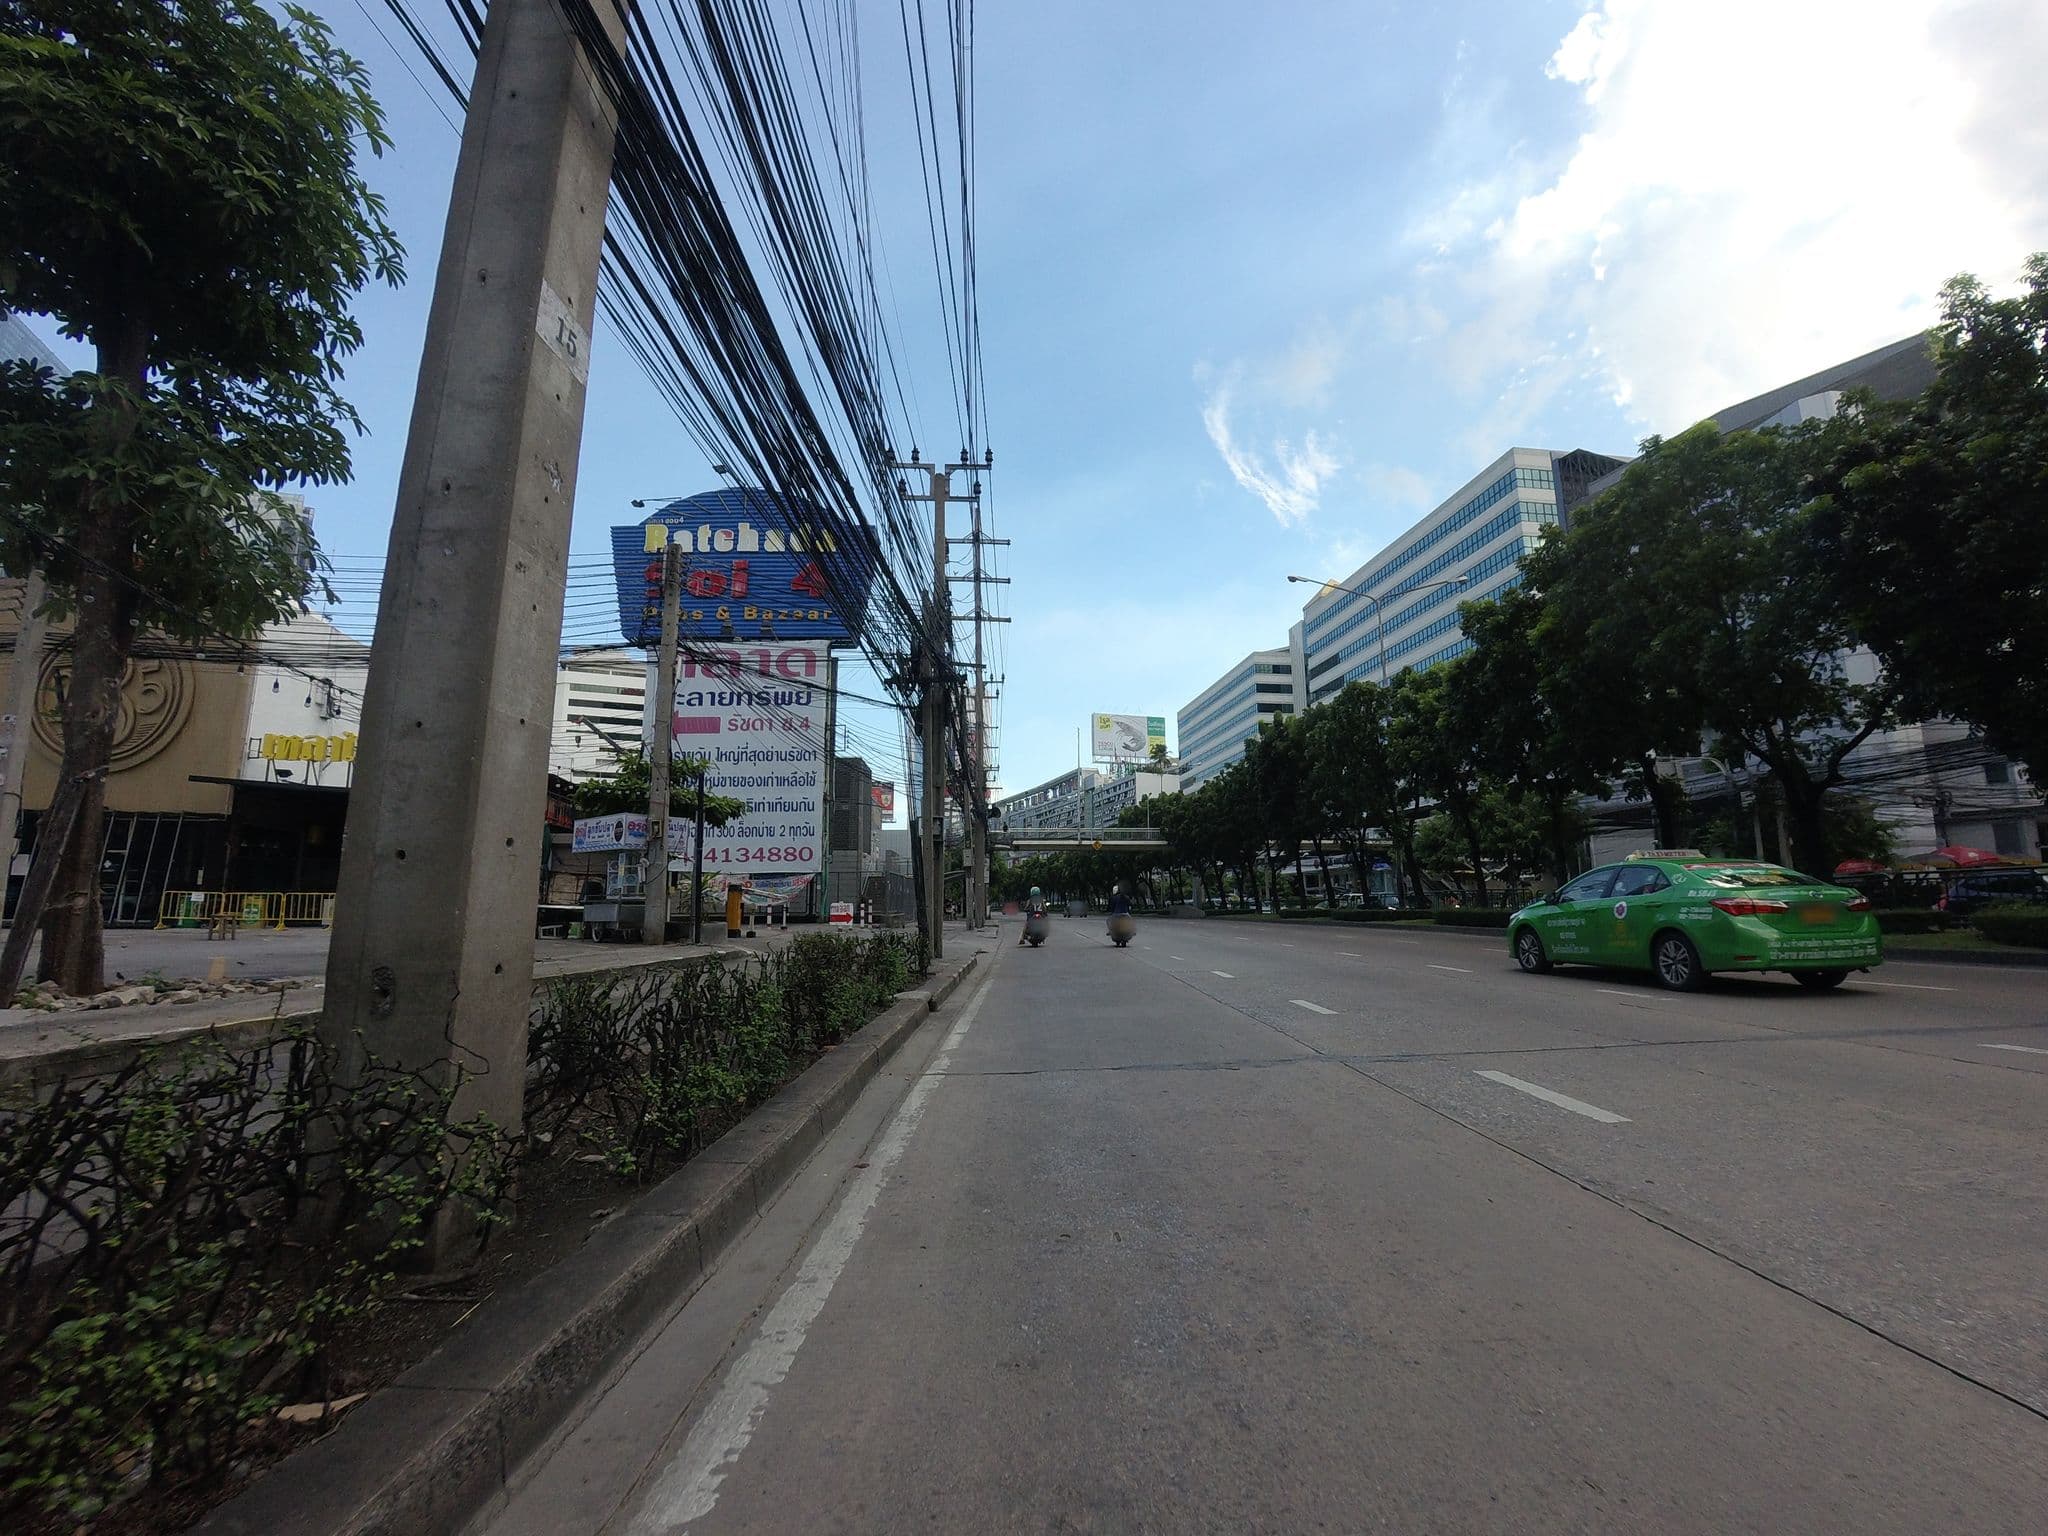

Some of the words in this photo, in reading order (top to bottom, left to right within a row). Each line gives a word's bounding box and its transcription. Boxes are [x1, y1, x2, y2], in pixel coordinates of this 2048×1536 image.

[556, 316, 577, 358] 15
[743, 605, 833, 621] Bazaar
[779, 825, 786, 837] 2
